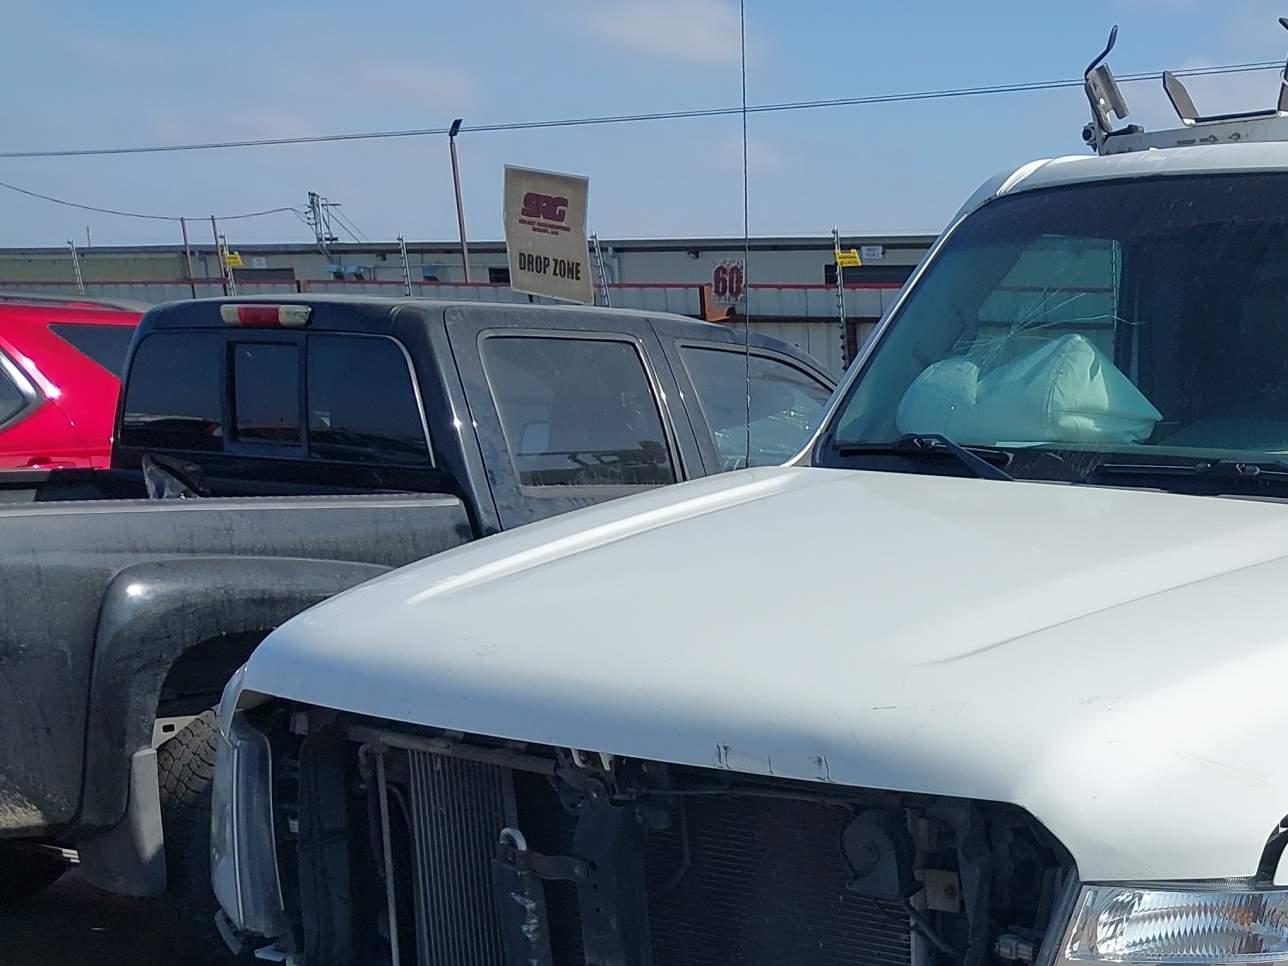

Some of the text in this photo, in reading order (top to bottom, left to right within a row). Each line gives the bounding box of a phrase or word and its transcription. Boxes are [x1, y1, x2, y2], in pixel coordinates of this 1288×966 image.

[521, 192, 568, 222] SRG
[518, 252, 581, 281] DROP ZONE
[713, 265, 742, 297] 60
